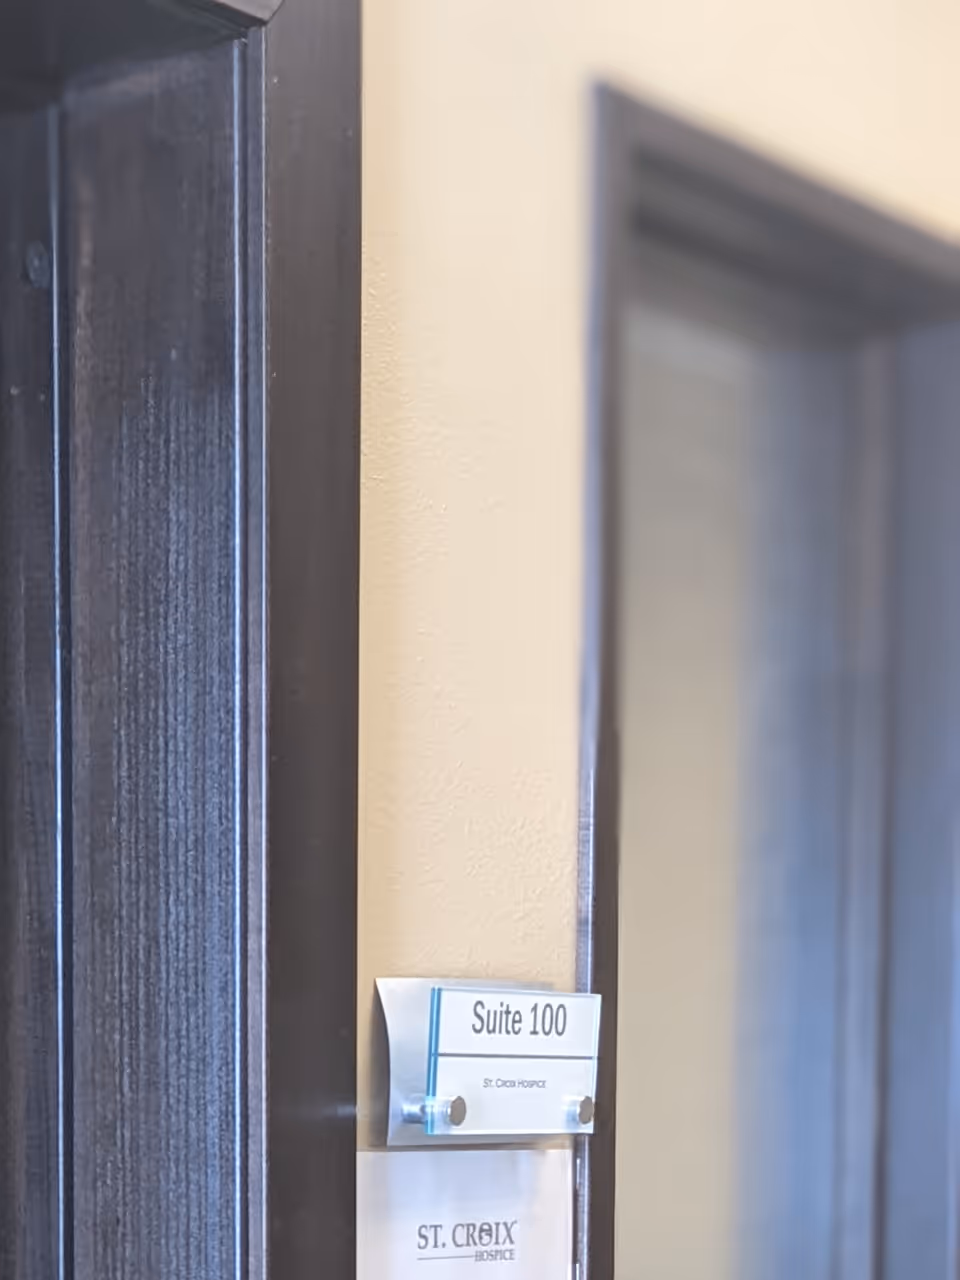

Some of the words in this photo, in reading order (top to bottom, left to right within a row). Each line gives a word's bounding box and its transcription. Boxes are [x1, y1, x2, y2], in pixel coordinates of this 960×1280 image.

[471, 1000, 523, 1036] Suite
[529, 1002, 567, 1037] 100
[417, 1224, 446, 1250] ST.
[451, 1220, 518, 1248] CROIX
[474, 1249, 516, 1262] HOSPICE
